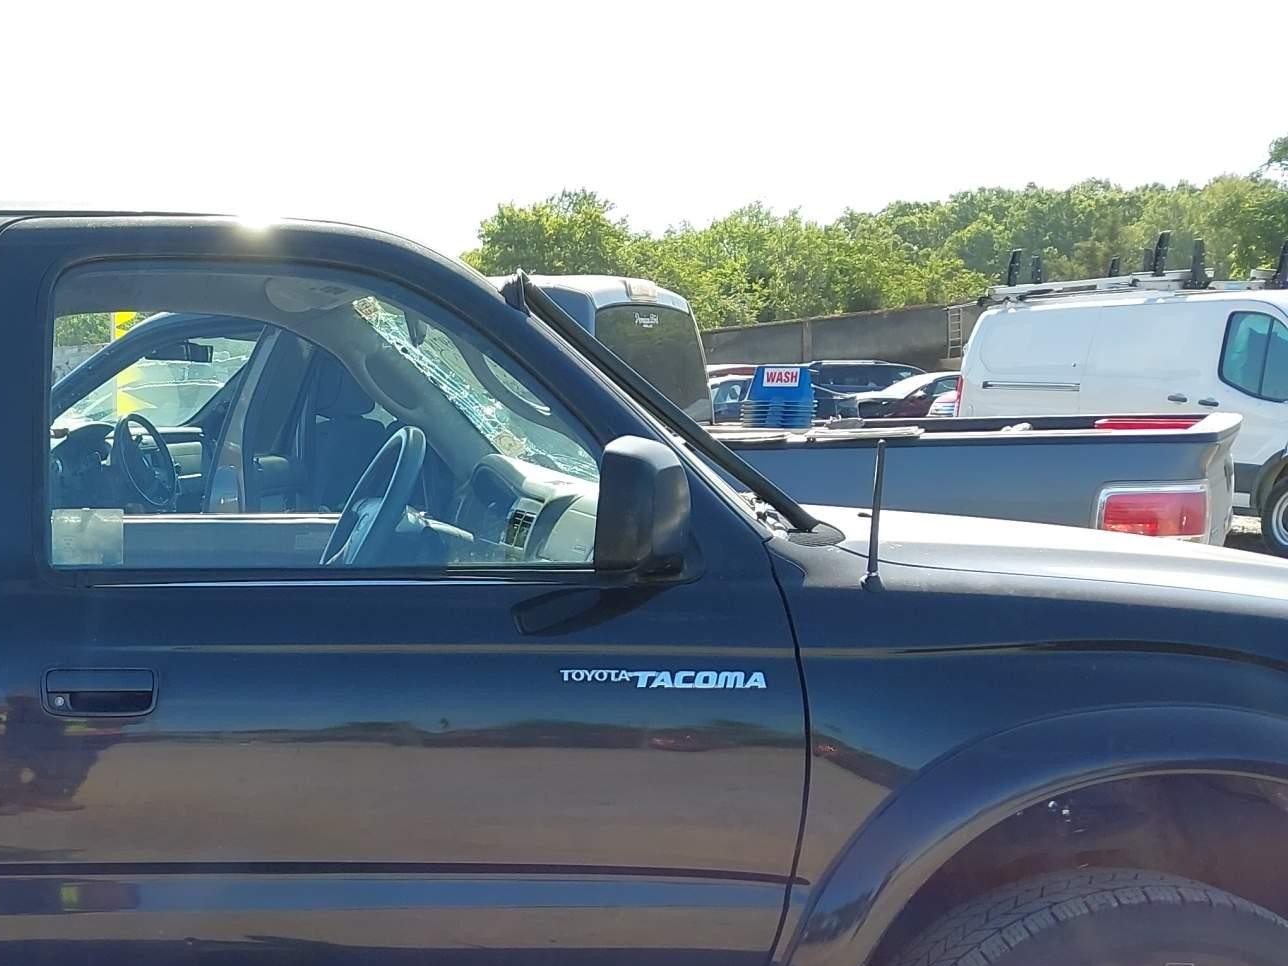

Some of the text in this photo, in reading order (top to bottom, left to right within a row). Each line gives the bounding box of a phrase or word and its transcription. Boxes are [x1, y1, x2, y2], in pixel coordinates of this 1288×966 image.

[766, 371, 798, 383] WASH
[560, 669, 767, 689] TOYOTA TACOMA
